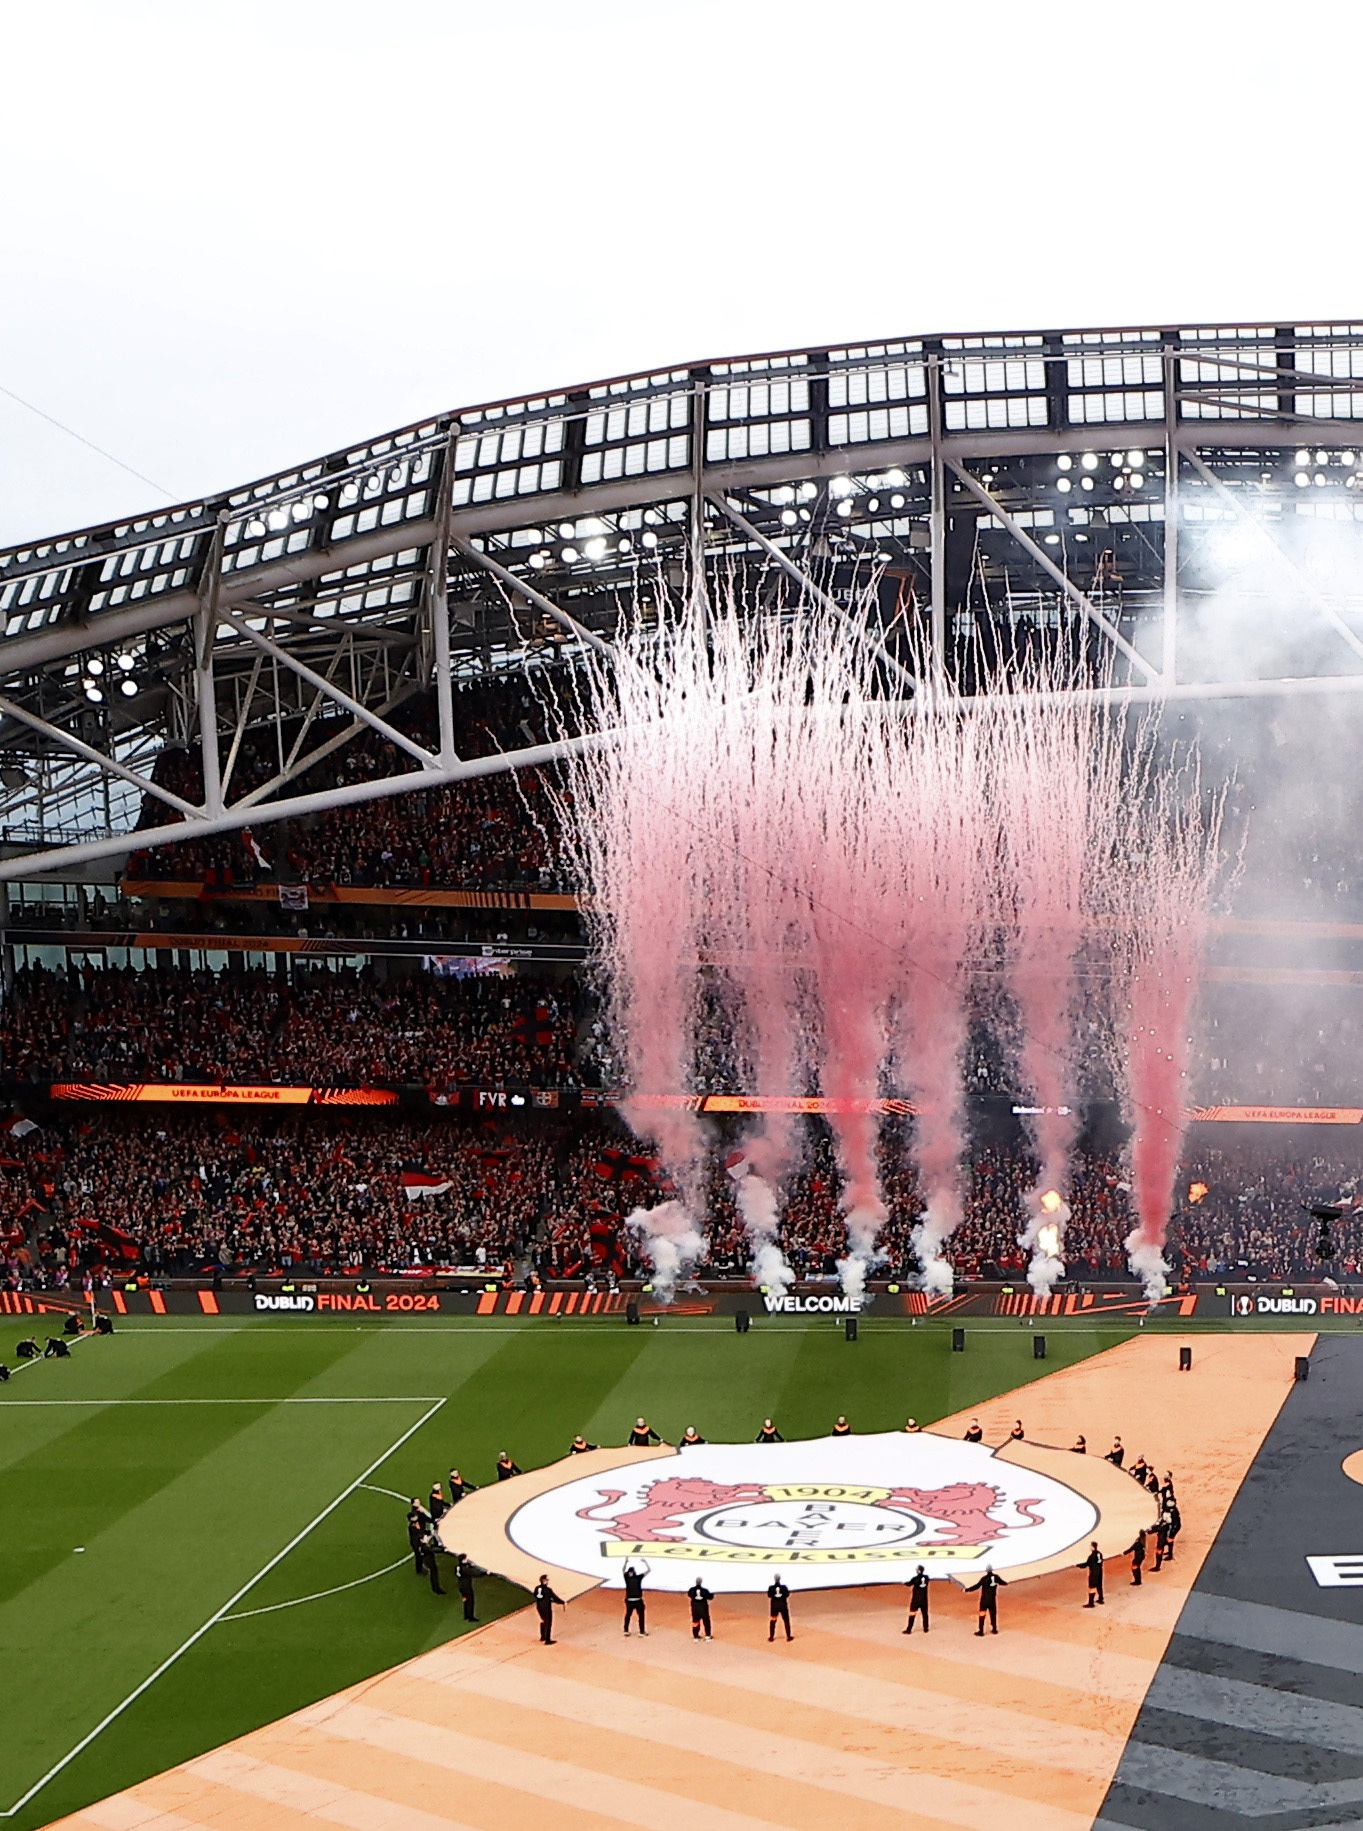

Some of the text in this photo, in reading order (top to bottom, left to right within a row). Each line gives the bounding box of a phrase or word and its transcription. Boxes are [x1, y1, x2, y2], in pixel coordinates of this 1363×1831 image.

[172, 1089, 280, 1099] UEFA EUROPA LEAGUE
[1270, 1111, 1302, 1119] EUROPA
[1304, 1111, 1337, 1120] LEAGUE
[254, 1294, 440, 1312] DUBLIN FINAL 2024
[764, 1296, 862, 1312] WELCOME
[1257, 1297, 1317, 1314] DUBLIN
[776, 1486, 875, 1499] 1904
[715, 1518, 907, 1533] BAYER
[630, 1544, 956, 1562] Leverkusen
[919, 1576, 927, 1588] 1
[990, 1575, 996, 1587] 1
[537, 1587, 544, 1599] 1
[695, 1589, 704, 1600] 1
[774, 1586, 783, 1598] 1
